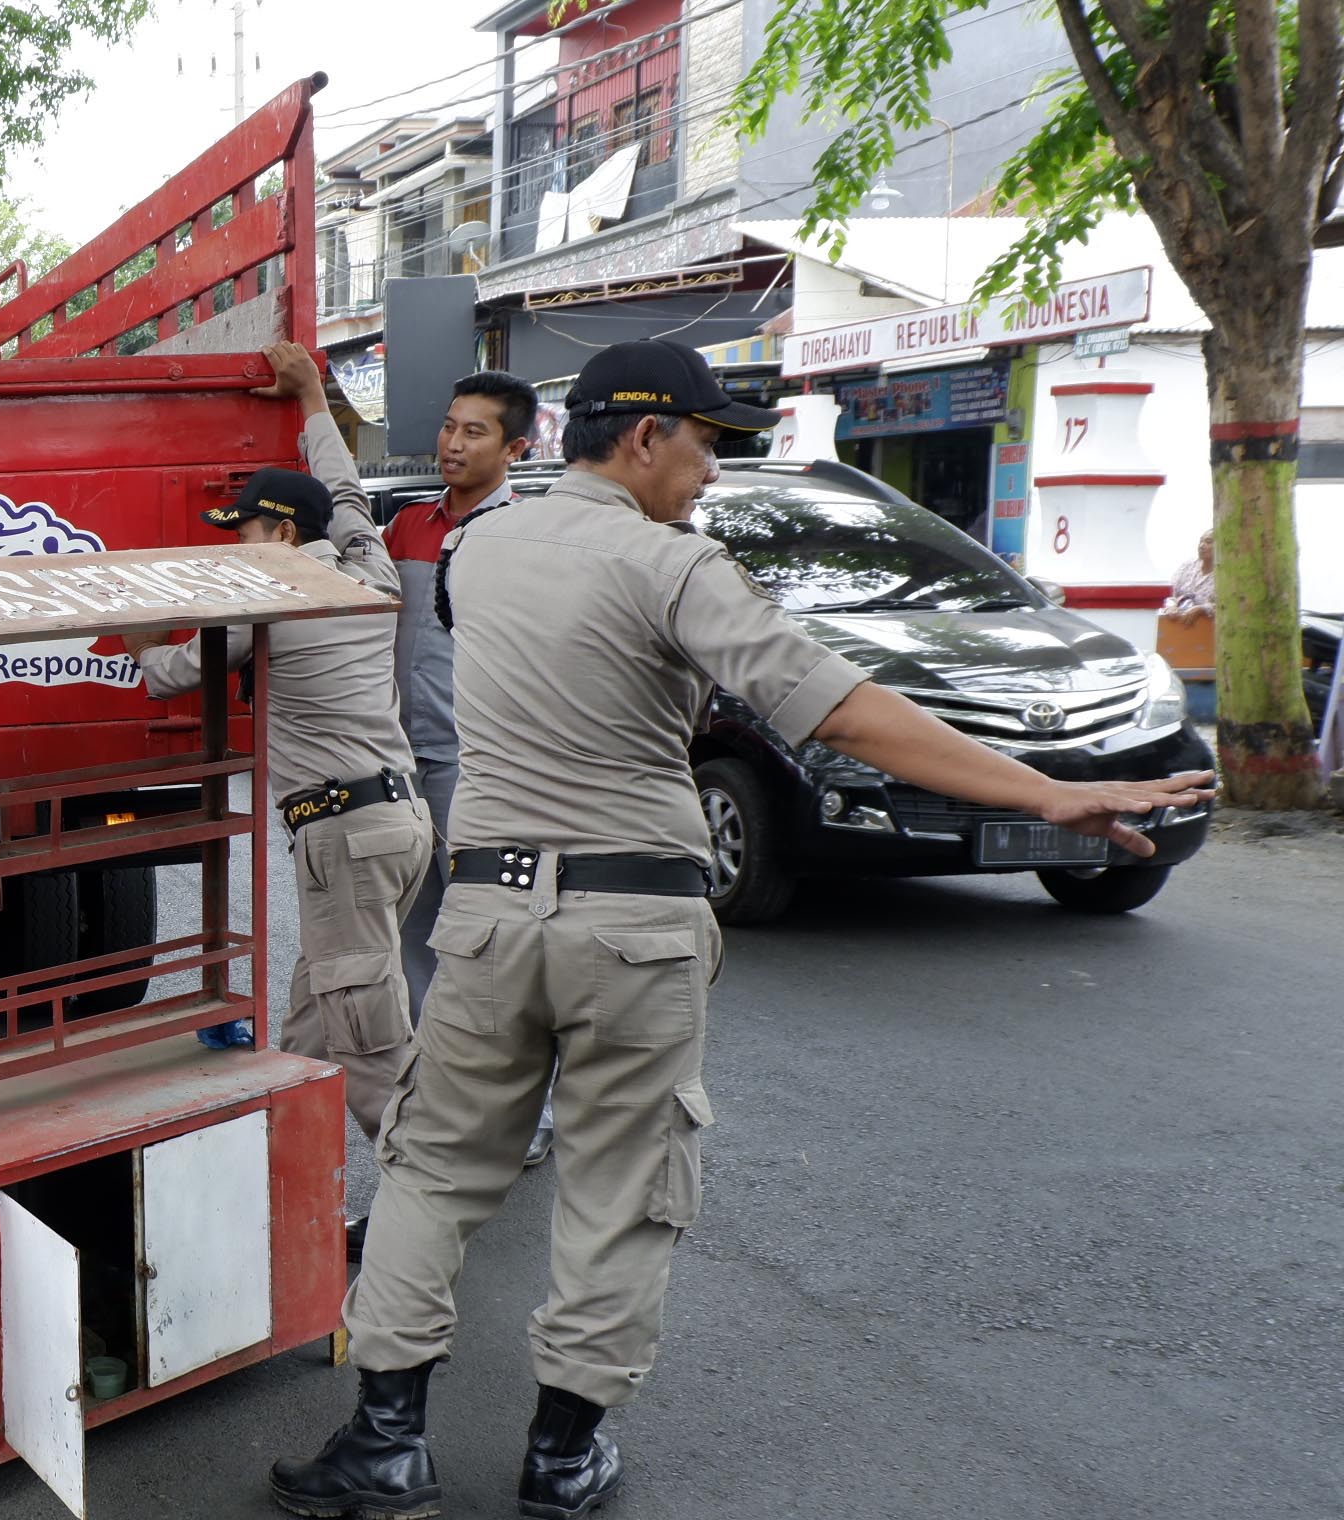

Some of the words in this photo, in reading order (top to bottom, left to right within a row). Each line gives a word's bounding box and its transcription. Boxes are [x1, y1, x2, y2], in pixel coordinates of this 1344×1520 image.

[802, 329, 872, 367] DIRGAHAYU
[897, 312, 978, 351] REPUBLIK
[1010, 284, 1111, 332] NDONESIA
[613, 391, 657, 401] HENDRA
[779, 434, 794, 459] 17
[1061, 417, 1088, 455] 17
[1054, 515, 1070, 554] 8
